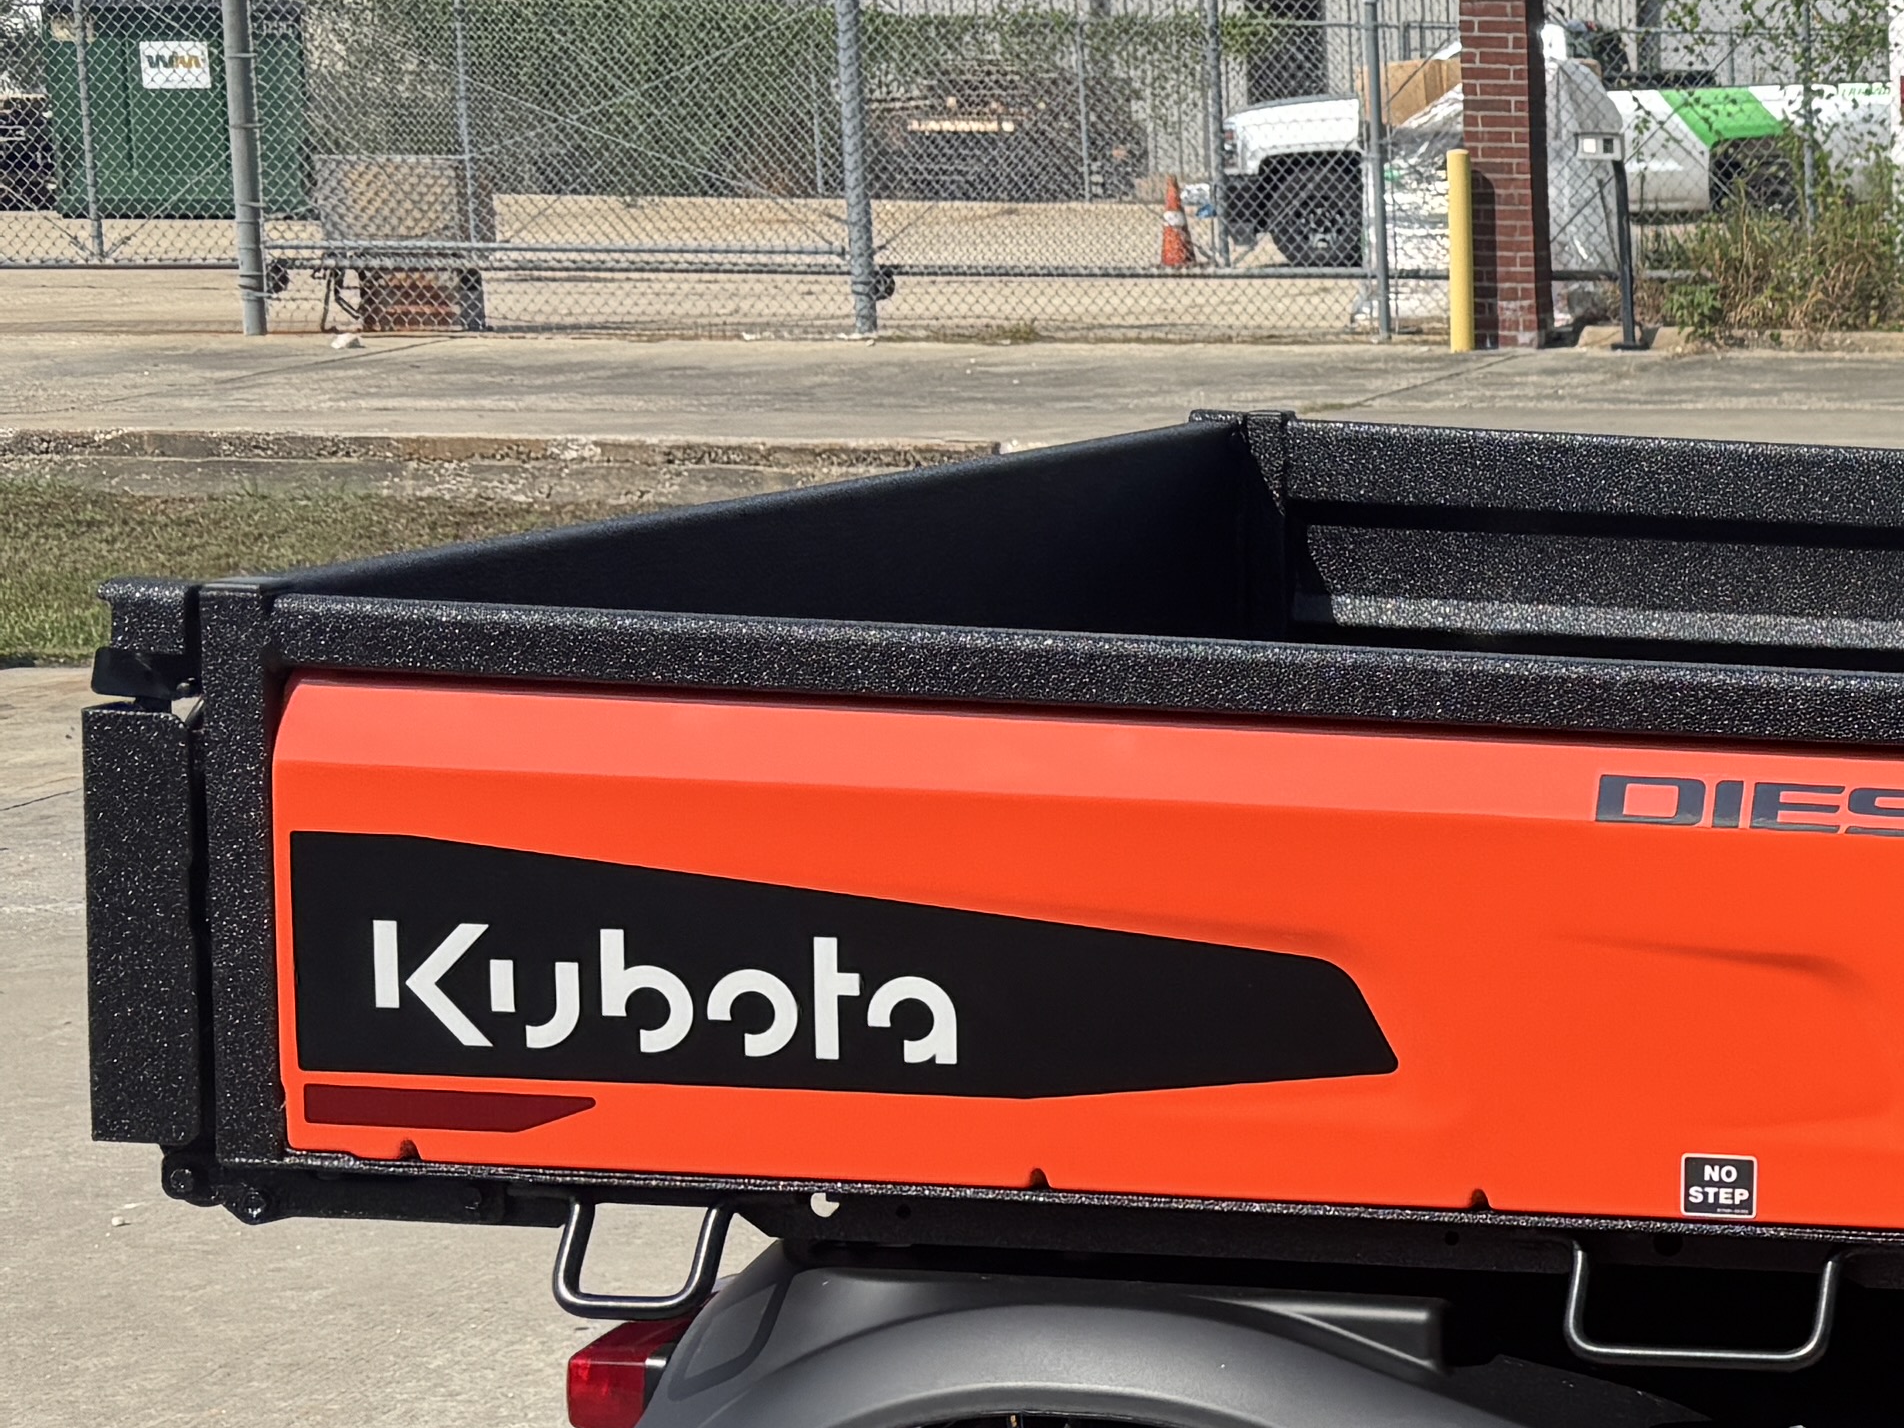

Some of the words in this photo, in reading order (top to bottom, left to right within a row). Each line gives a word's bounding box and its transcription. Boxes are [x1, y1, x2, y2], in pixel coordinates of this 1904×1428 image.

[372, 920, 957, 1066] Kubota
[1703, 1164, 1738, 1183] NO
[1688, 1185, 1750, 1205] STEP
